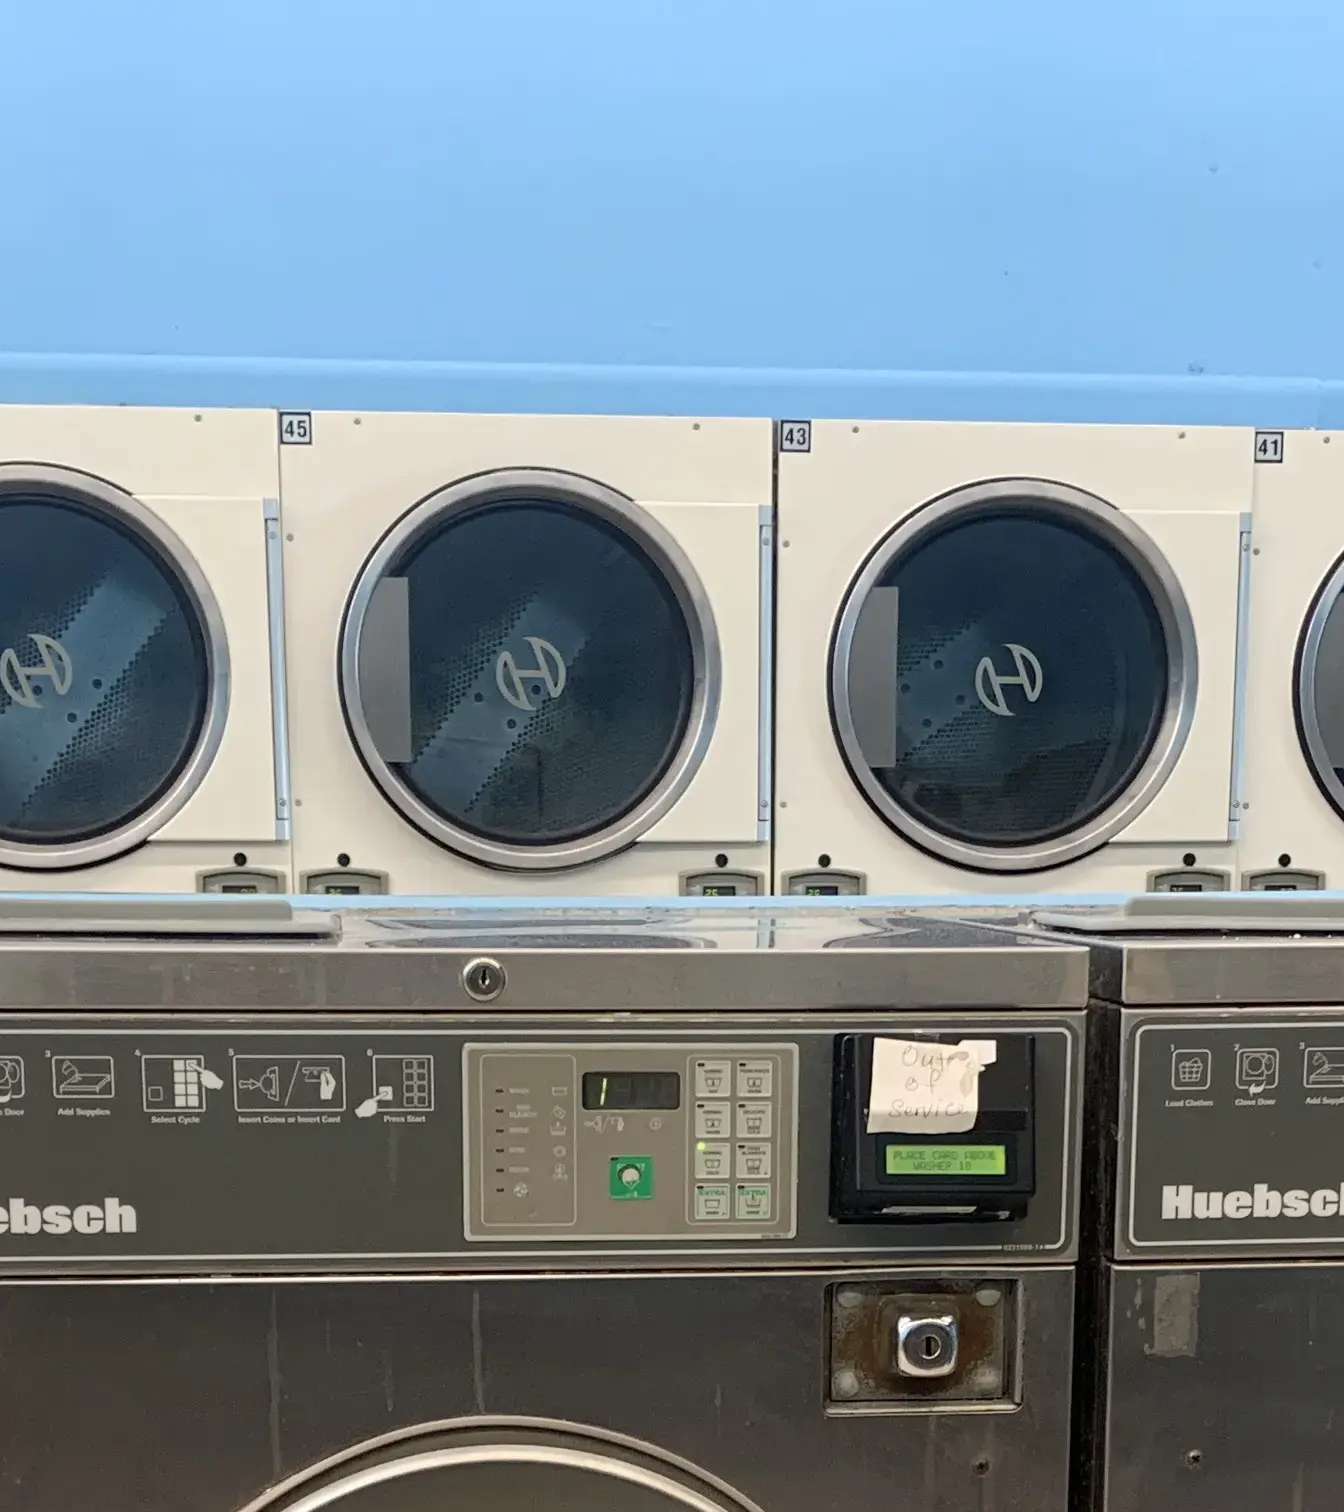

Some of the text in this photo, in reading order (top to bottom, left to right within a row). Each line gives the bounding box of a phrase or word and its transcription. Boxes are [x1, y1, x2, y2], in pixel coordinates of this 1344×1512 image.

[284, 420, 307, 438] 45
[784, 428, 806, 445] 43
[1259, 438, 1279, 456] 41
[893, 1150, 926, 1160] PLACE
[932, 1151, 958, 1160] CARD
[913, 1162, 951, 1171] WASHER
